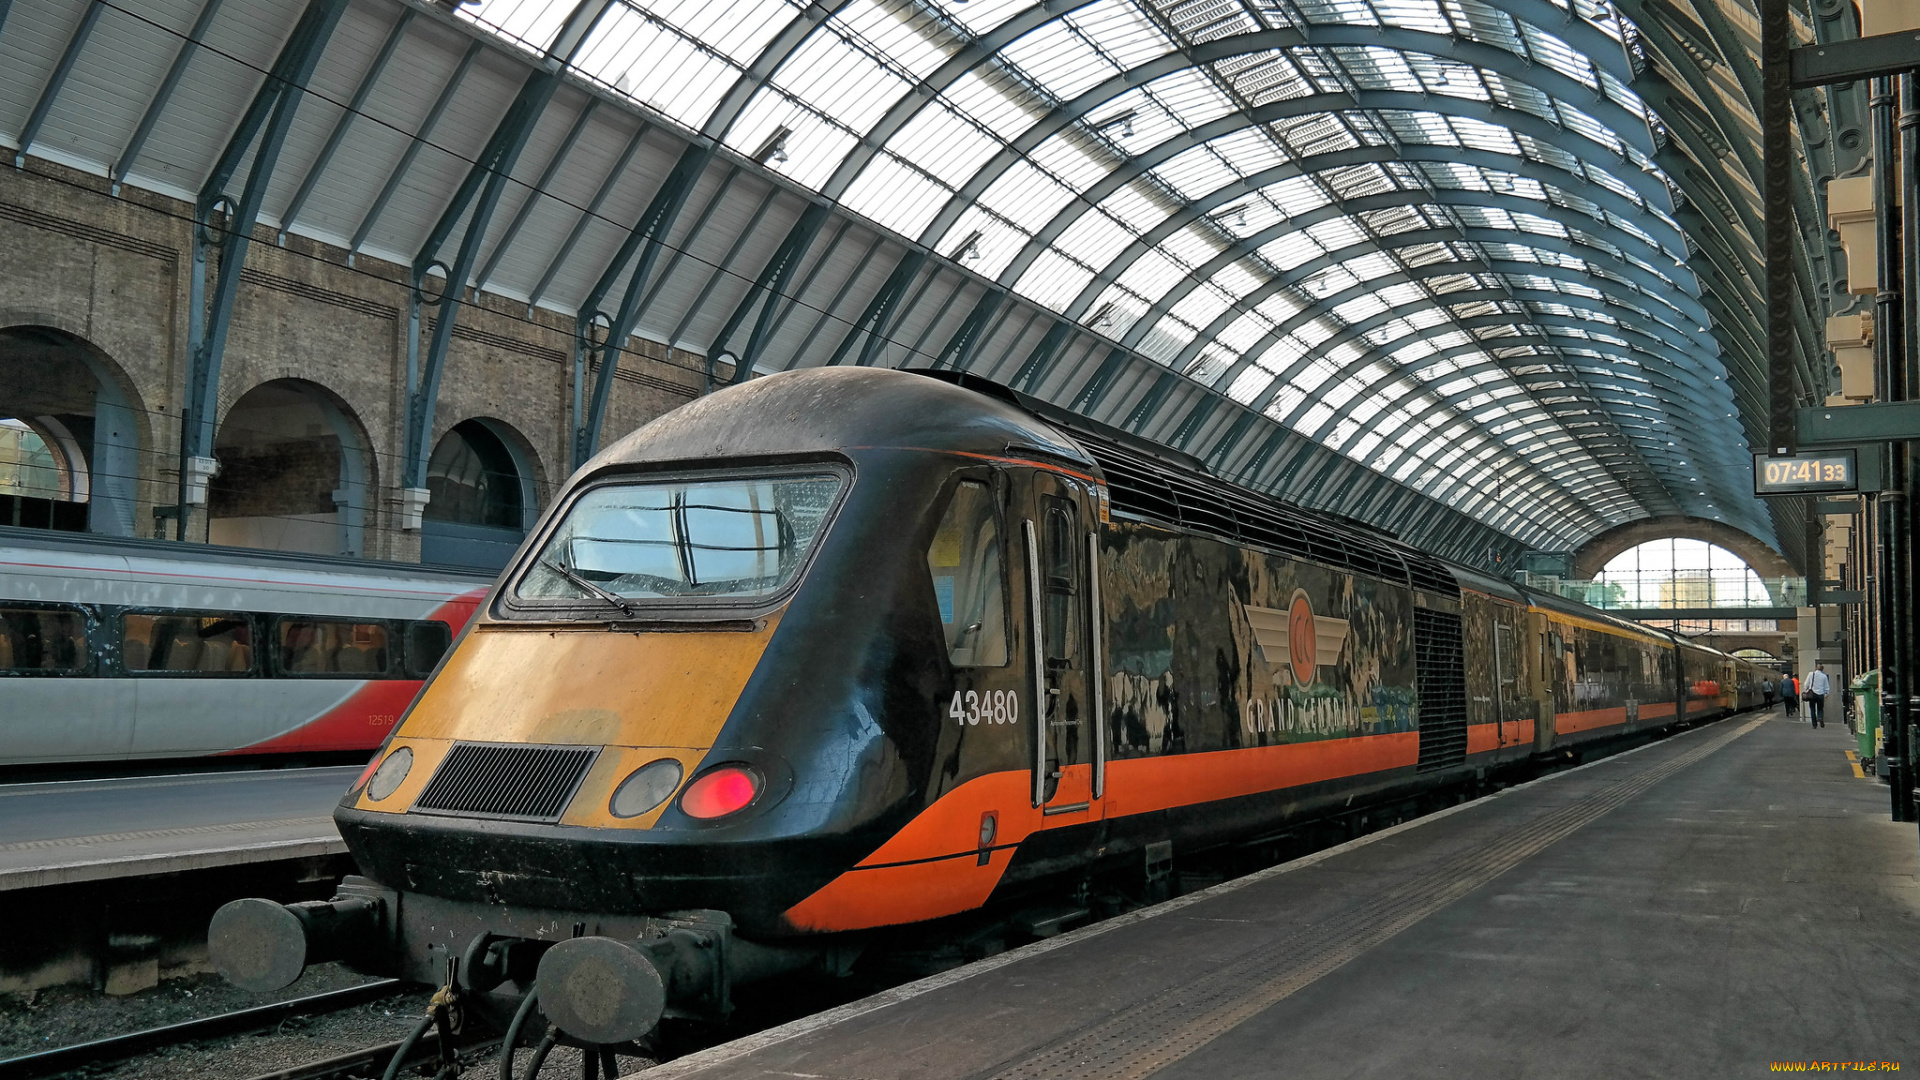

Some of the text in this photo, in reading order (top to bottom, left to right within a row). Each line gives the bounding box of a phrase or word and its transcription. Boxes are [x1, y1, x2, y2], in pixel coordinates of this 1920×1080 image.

[1824, 464, 1845, 481] 33
[368, 714, 394, 726] 12519
[949, 689, 1018, 726] 43480
[1246, 697, 1354, 733] GRAND CENTRAL
